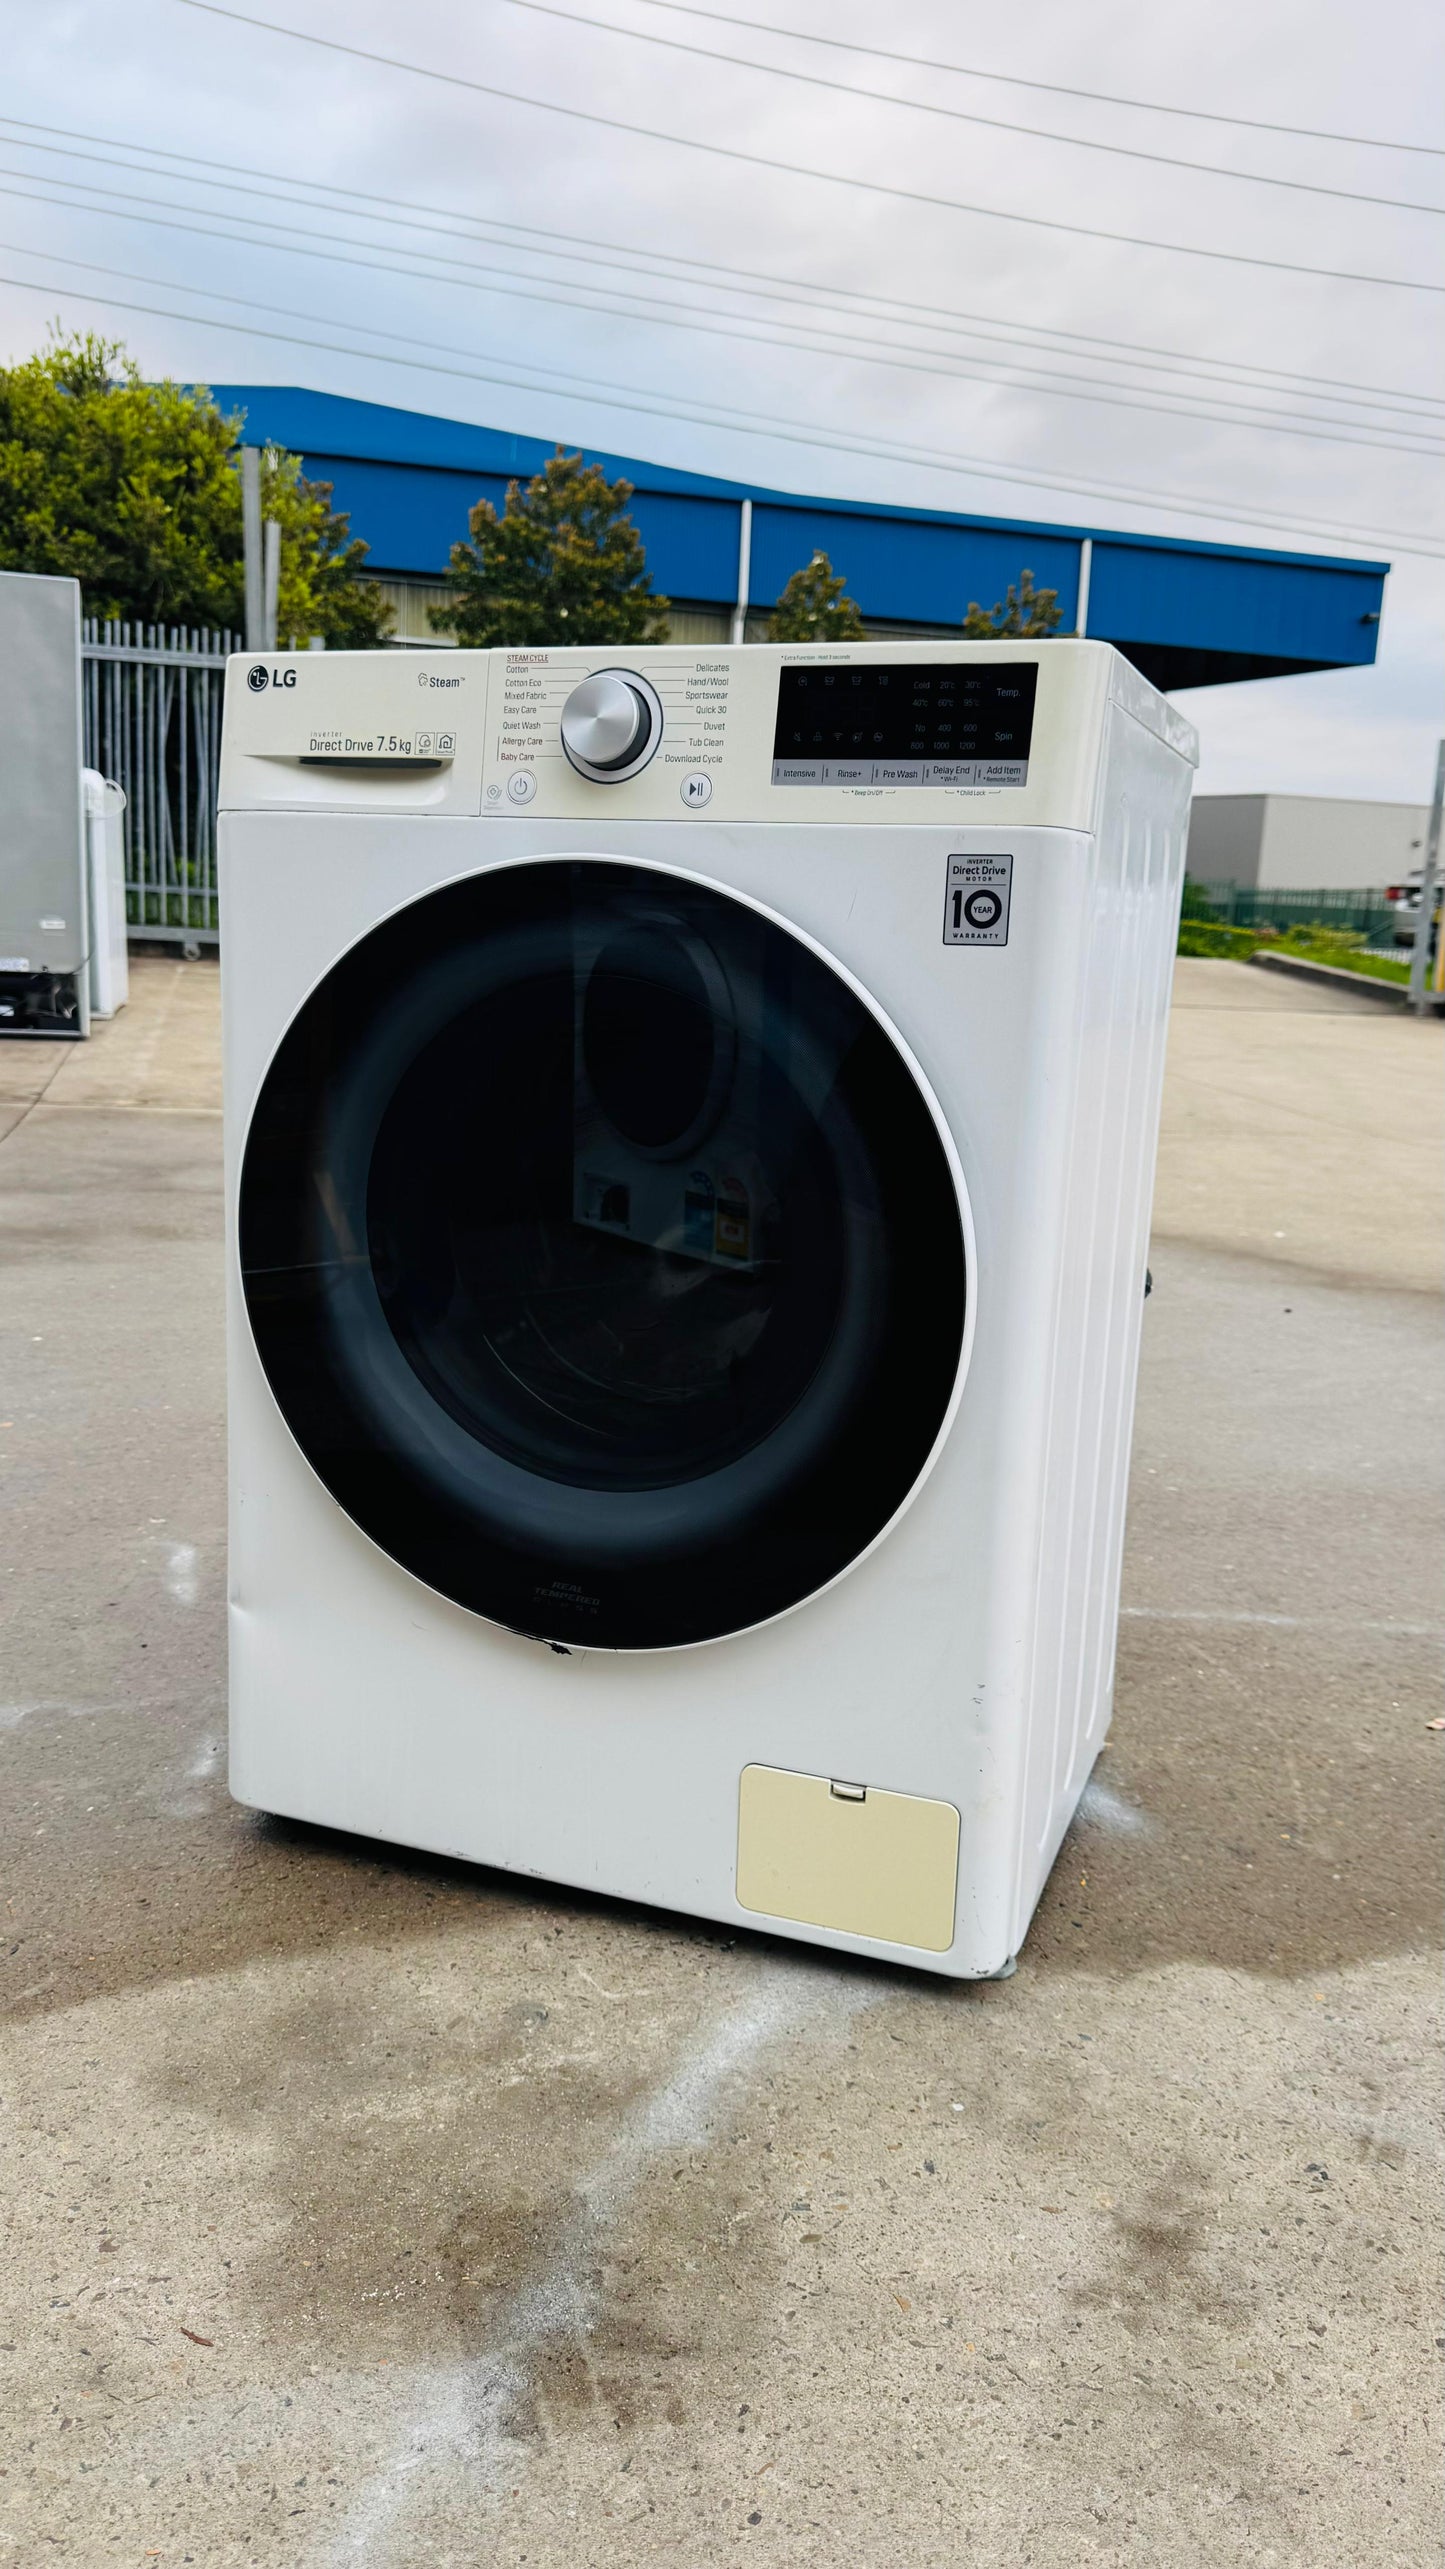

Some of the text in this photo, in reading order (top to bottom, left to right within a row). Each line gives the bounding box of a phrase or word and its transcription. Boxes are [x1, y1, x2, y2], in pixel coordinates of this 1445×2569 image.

[507, 654, 549, 662] STEAM CYCLE
[506, 665, 529, 674] Cotton
[696, 663, 730, 672] Delicates
[273, 669, 297, 688] LG
[505, 678, 542, 687] Cotton Eco
[687, 677, 729, 686] Hand/Wool
[913, 681, 931, 689] Cold
[504, 691, 547, 700] Mixed Fabric
[685, 691, 728, 701] Sportswear
[996, 687, 1021, 698] Temp.
[503, 706, 537, 715] Easy Care
[696, 705, 727, 714] Quick 30
[502, 721, 541, 731] Quiet Wash
[704, 722, 725, 731] Duvet
[994, 731, 1013, 743] Spin
[310, 739, 342, 752] Direct
[345, 739, 373, 751] Drive
[502, 737, 543, 747] Allergy Care
[689, 738, 724, 747] Tub Clean
[500, 753, 535, 763] Baby Care
[665, 754, 723, 765] Download Cycle
[783, 769, 816, 778] Intensive
[837, 769, 862, 778] Rinse+
[883, 769, 918, 778] Pre Wash
[933, 765, 970, 775] Delay End
[986, 766, 1021, 775] Add Item
[953, 866, 1006, 875] Direct Drive
[952, 889, 1002, 929] 10
[973, 906, 993, 914] YEAR
